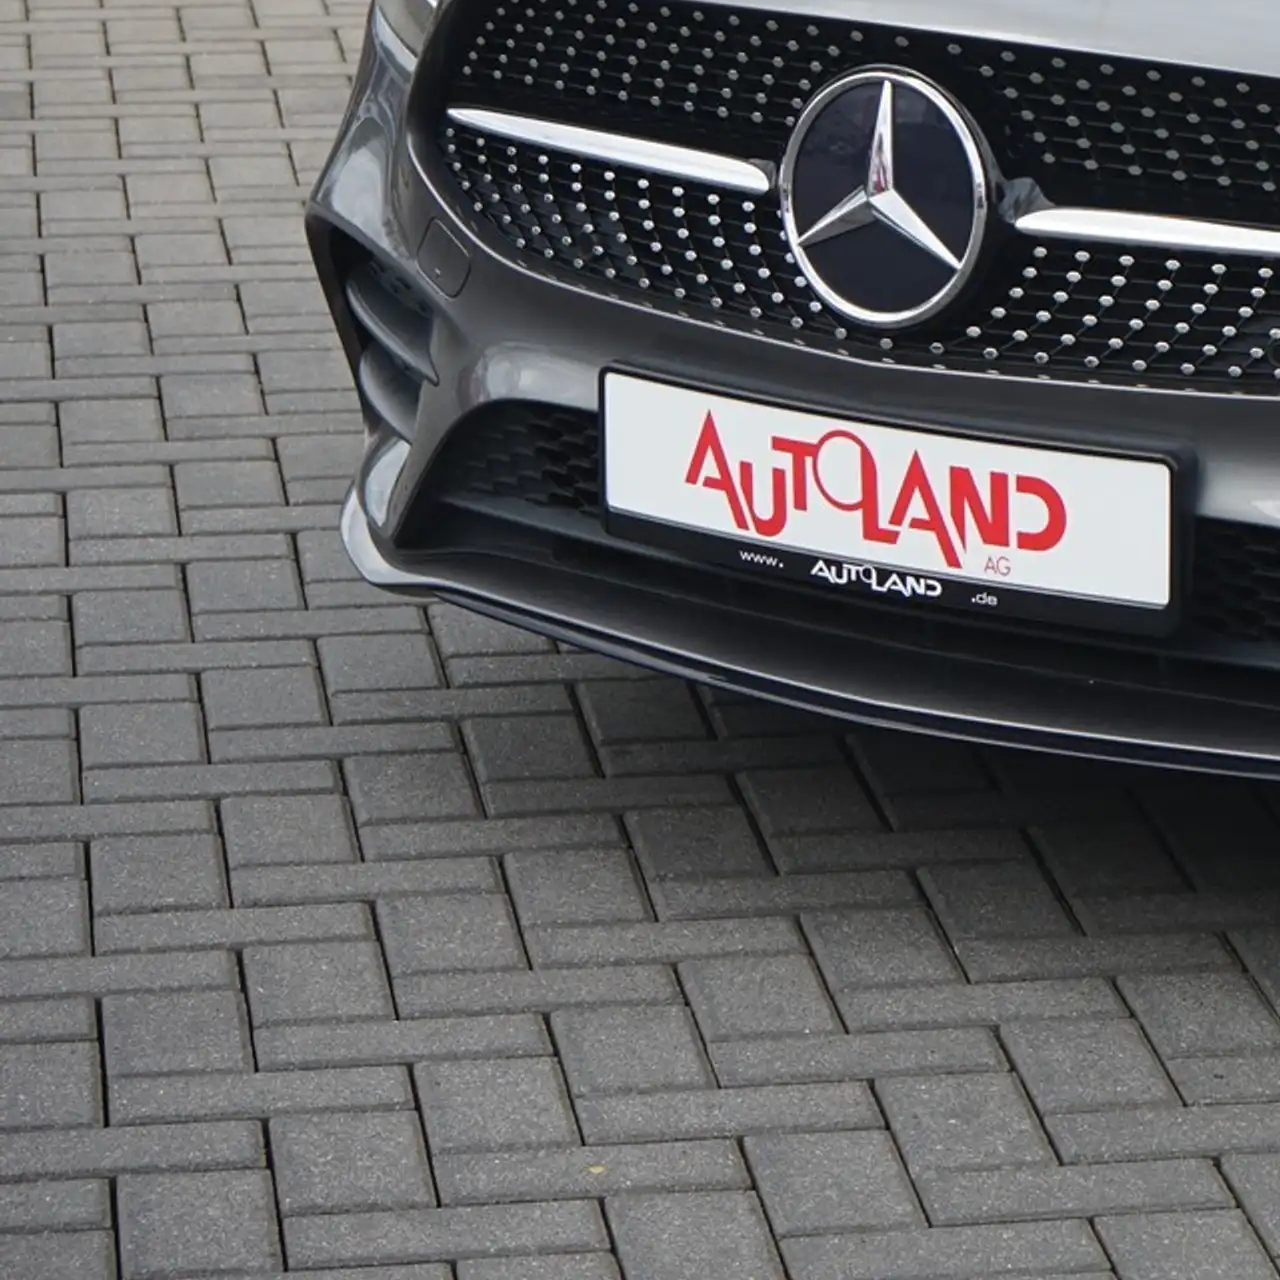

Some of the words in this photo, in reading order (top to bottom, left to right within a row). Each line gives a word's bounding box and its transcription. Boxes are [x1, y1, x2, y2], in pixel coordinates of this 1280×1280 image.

[685, 409, 1067, 569] AUTOLAND
[739, 549, 784, 568] www.
[810, 559, 943, 597] AUTOLAND
[970, 591, 999, 607] .de
[984, 555, 1012, 577] AG
